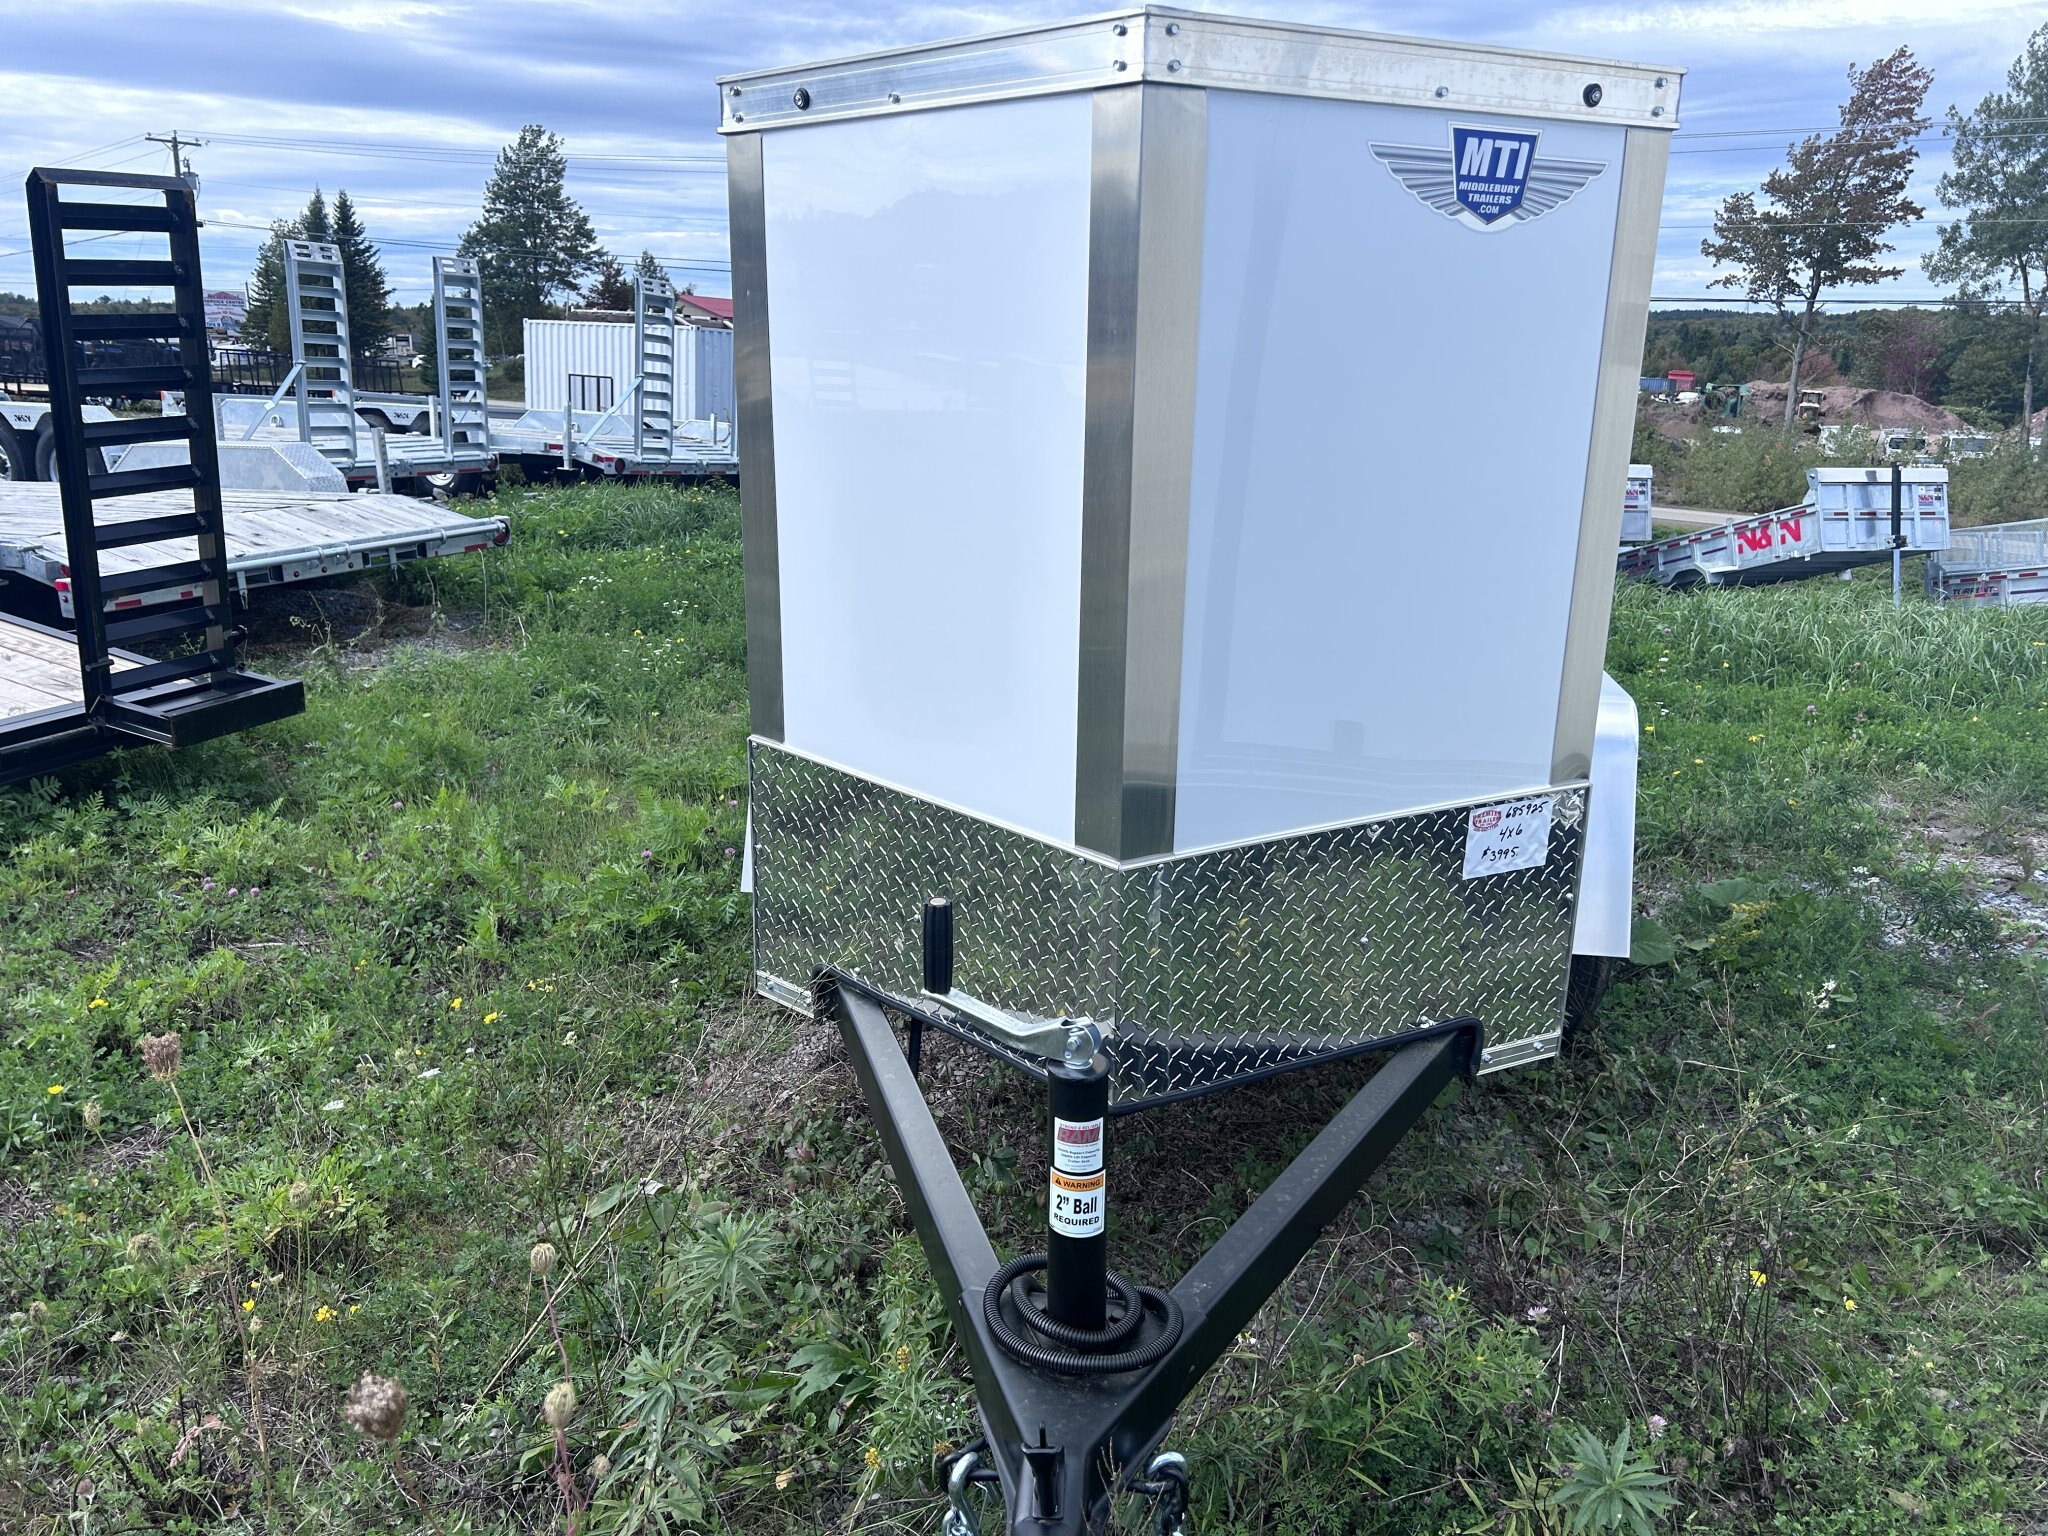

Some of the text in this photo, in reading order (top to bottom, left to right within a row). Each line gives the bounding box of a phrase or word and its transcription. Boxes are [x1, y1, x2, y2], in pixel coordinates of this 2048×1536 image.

[1460, 136, 1530, 180] MTI
[1458, 181, 1521, 194] MIDDLEBURY
[1468, 193, 1512, 205] TRAILERS
[1477, 204, 1500, 215] .COM
[1505, 801, 1549, 819] 685925
[1058, 1127, 1100, 1144] RAM
[1063, 1178, 1101, 1189] WARNING
[1073, 1196, 1098, 1215] Ball
[1053, 1212, 1100, 1226] REQUIRED
